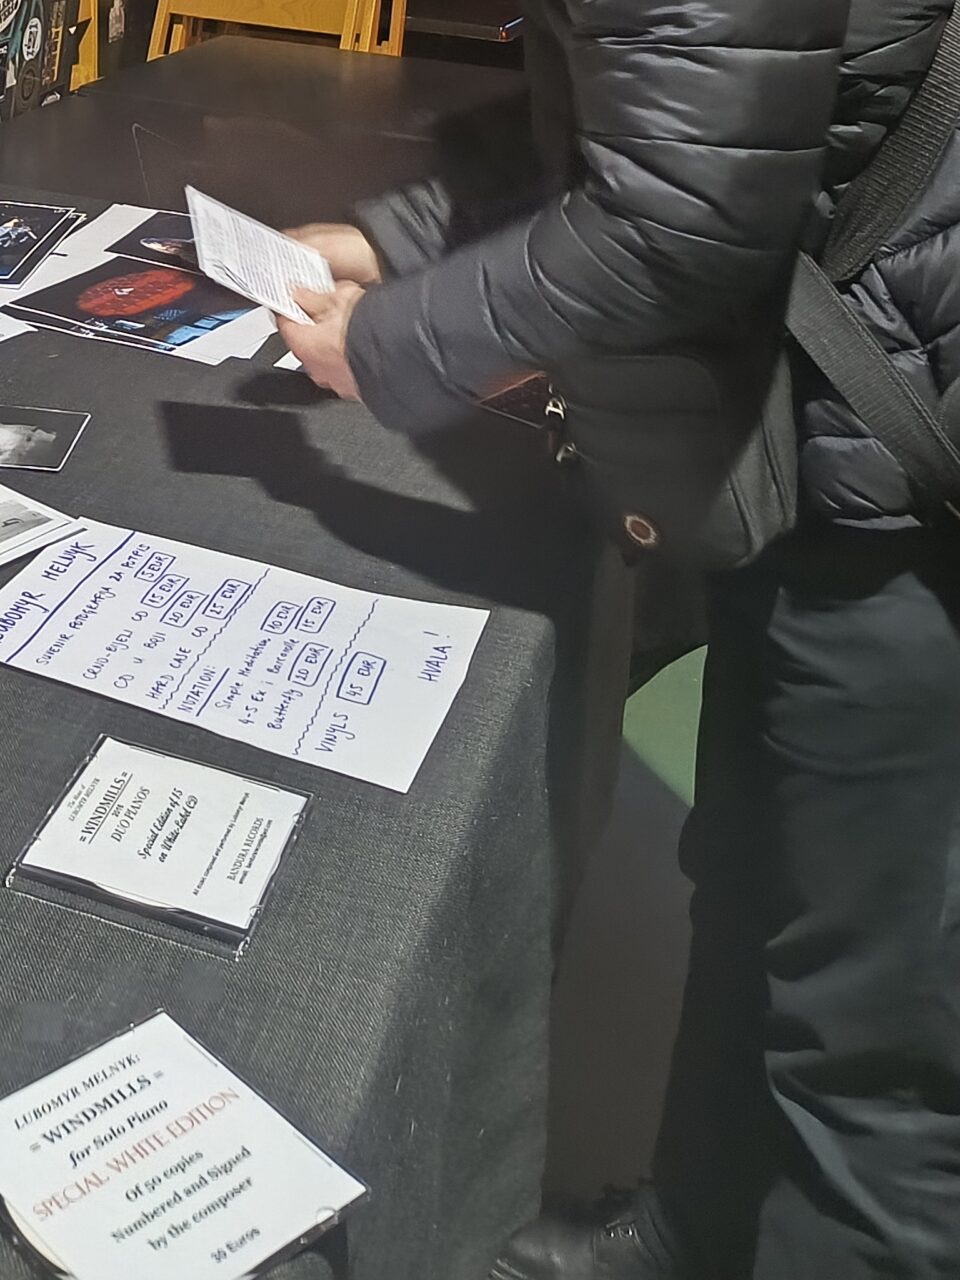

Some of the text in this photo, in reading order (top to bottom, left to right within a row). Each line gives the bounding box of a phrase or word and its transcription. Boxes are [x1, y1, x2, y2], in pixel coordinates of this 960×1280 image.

[41, 541, 98, 581] MELNYK
[151, 556, 169, 573] EUR
[36, 632, 74, 666] SUVENIR
[121, 543, 151, 569] POTPIS
[148, 577, 182, 604] 15 EUR
[168, 593, 202, 624] 20 EUR
[211, 583, 240, 616] 25 EUR
[269, 603, 292, 632] 10 EUR
[304, 600, 329, 630] 15 EUR
[82, 629, 134, 680] CRNO-BIJELI
[145, 625, 210, 701] HARD CASE CD
[294, 645, 327, 681] 20 EUR
[417, 644, 453, 683] HVALA
[113, 673, 135, 689] CD
[177, 665, 217, 714] NOTATION:
[345, 658, 378, 699] 45 EUR
[266, 687, 305, 731] Butterfly
[314, 710, 356, 753] VINYLS
[82, 777, 126, 836] WINDMILLS
[110, 785, 151, 843] DUO PIANOS
[136, 787, 184, 860] Special Edition of 15
[158, 852, 168, 863] on
[226, 848, 250, 881] BANDURA
[12, 1053, 141, 1132] LUBOMYR MELNYK:
[42, 1073, 152, 1145] WINDMILLS
[67, 1097, 170, 1169] for Solo Piano
[31, 1087, 241, 1223] SPECIAL WHITE EDITION
[160, 1148, 205, 1186] copies
[110, 1145, 253, 1245] Numbered and Signed
[147, 1175, 255, 1252] by the composer
[223, 1226, 262, 1257] Euros
